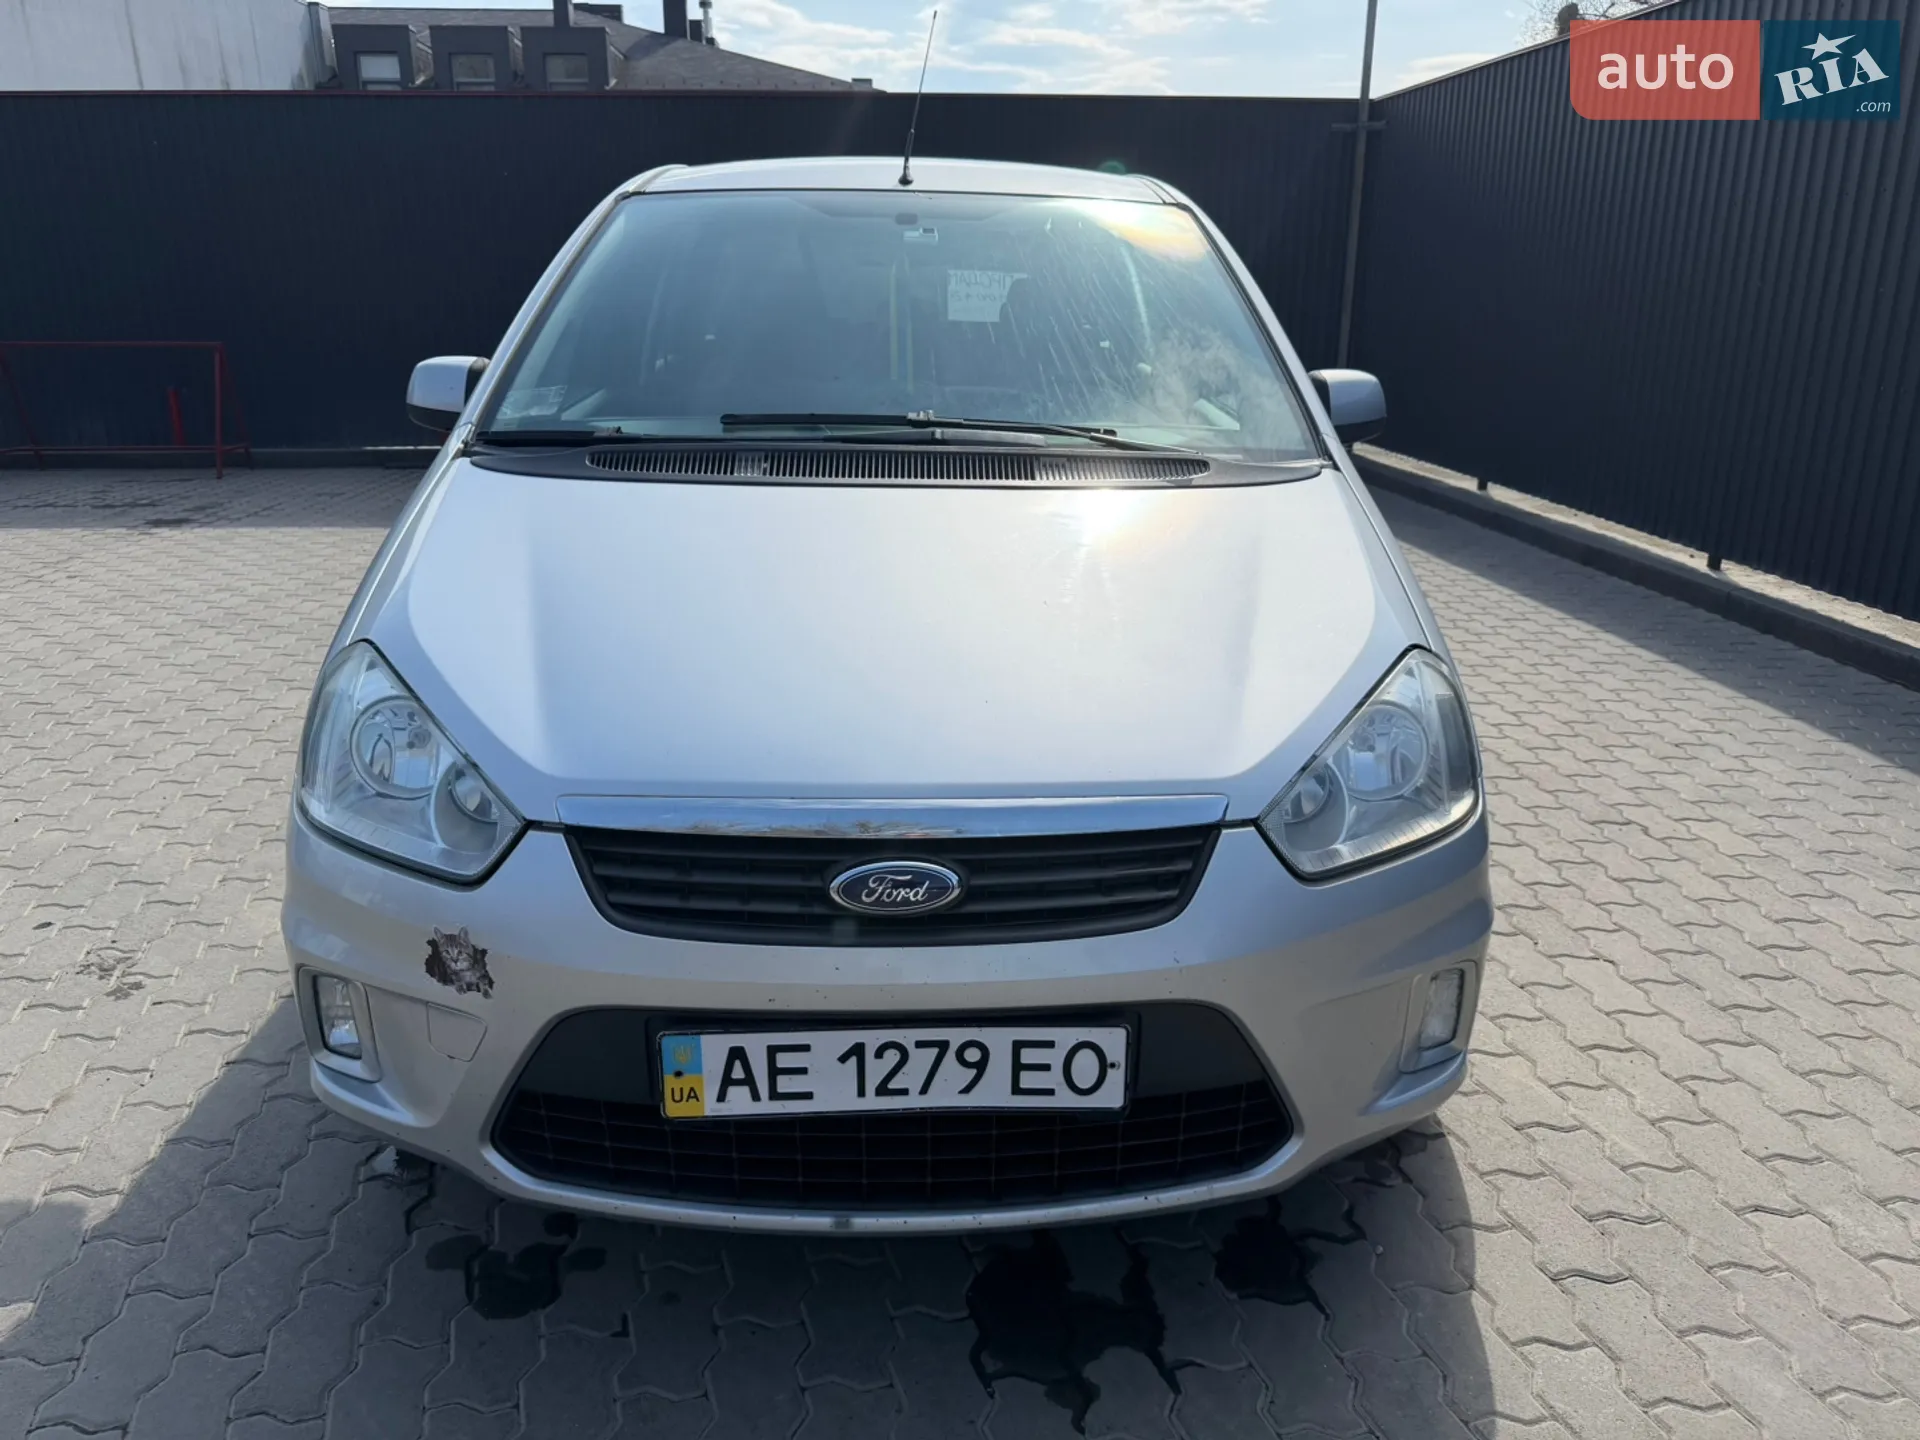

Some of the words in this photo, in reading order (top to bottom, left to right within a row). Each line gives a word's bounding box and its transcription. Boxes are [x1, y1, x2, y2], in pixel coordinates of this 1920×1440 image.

[861, 874, 929, 902] Ford
[716, 1044, 813, 1103] AE
[836, 1039, 990, 1098] 1279
[1011, 1039, 1108, 1096] EO
[671, 1087, 700, 1103] UA
